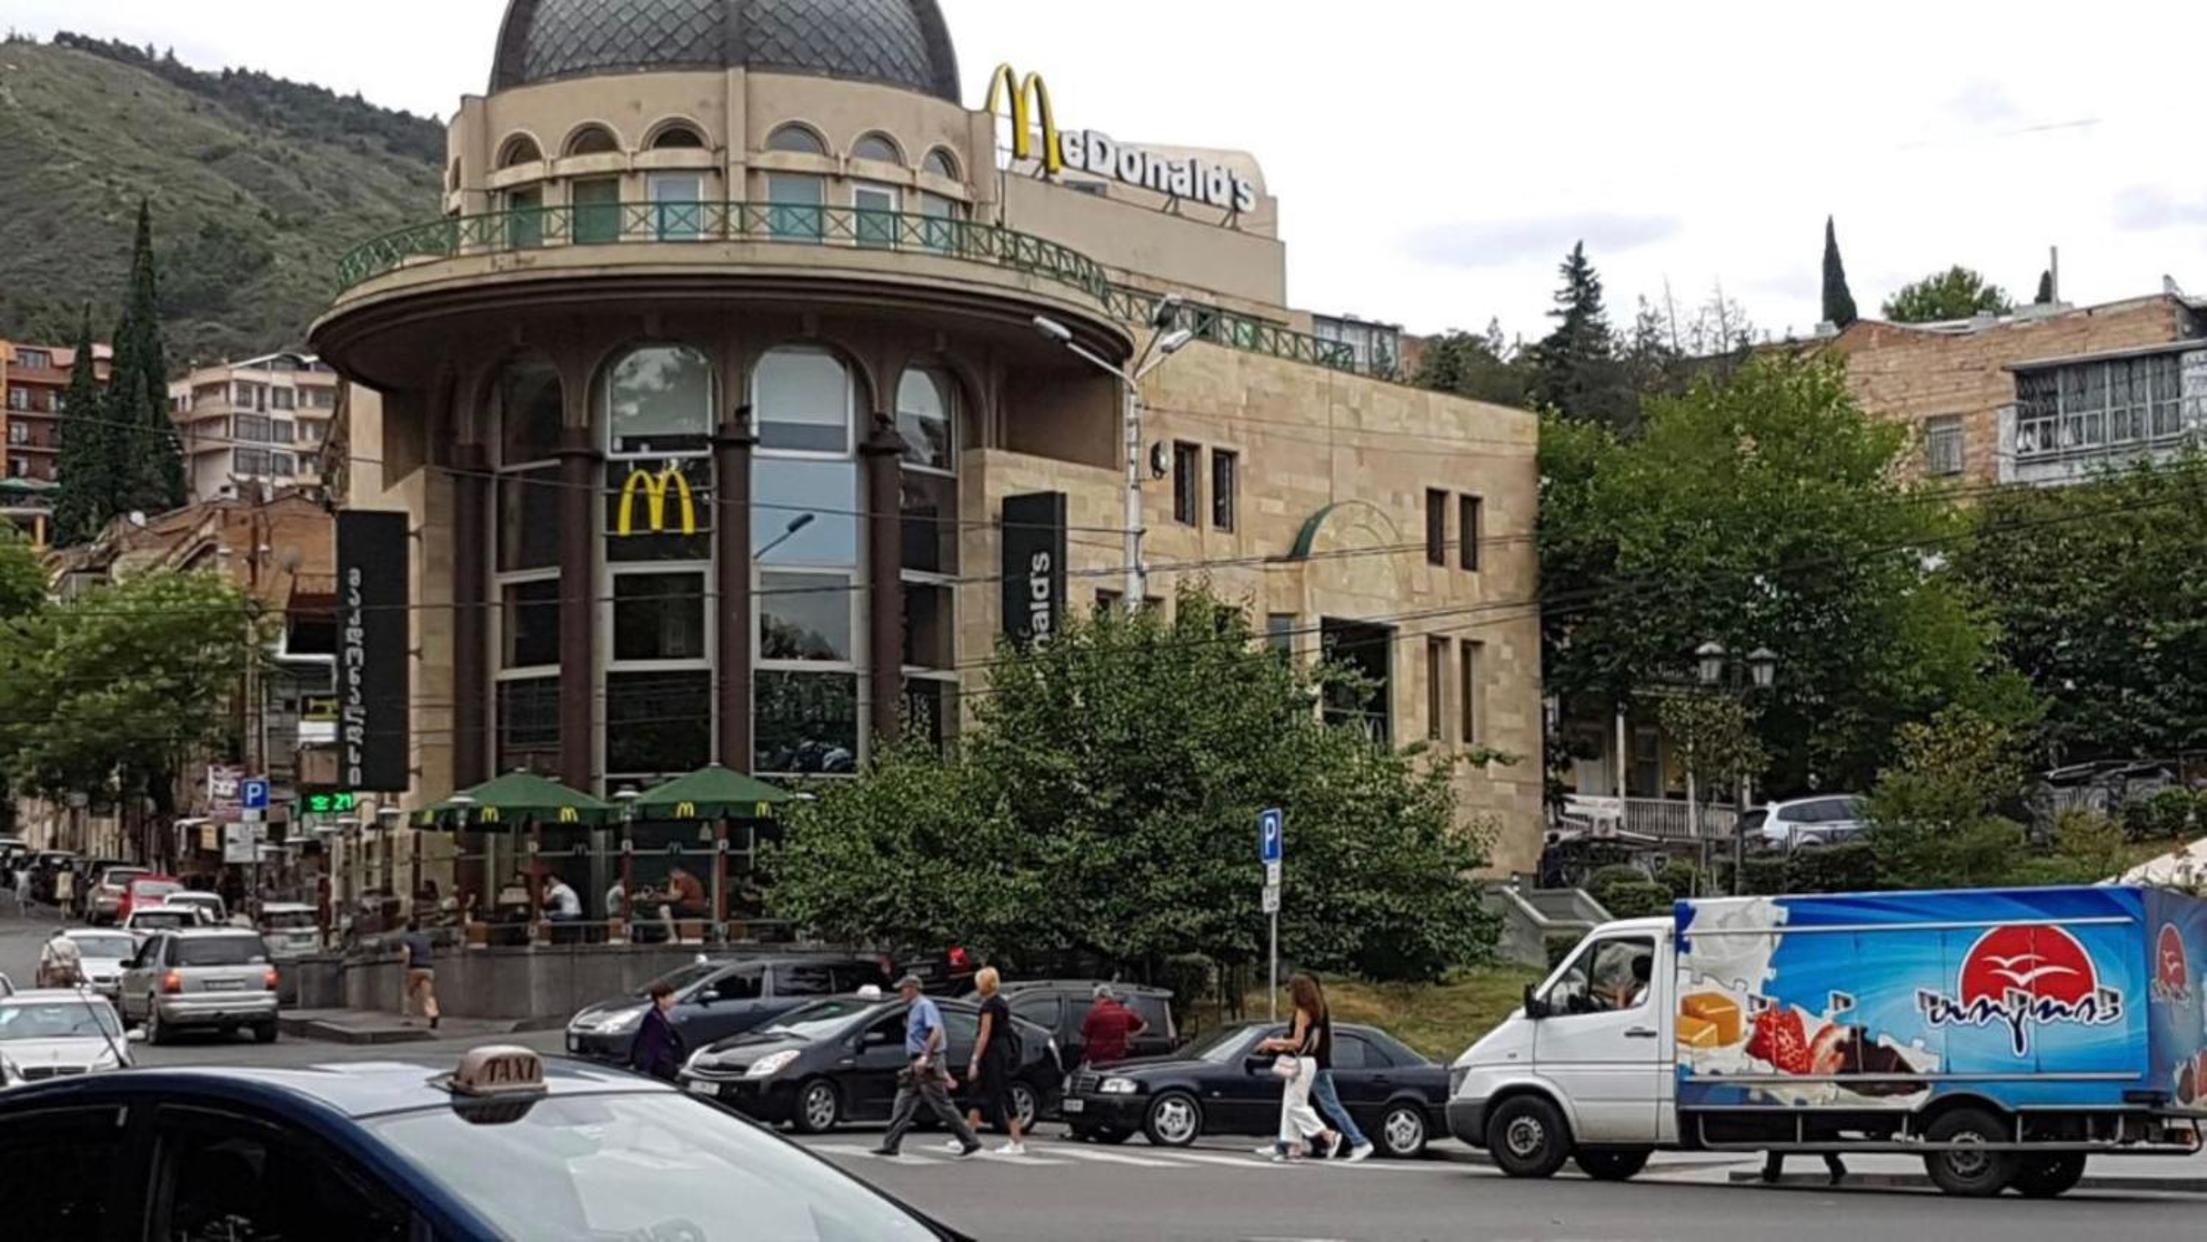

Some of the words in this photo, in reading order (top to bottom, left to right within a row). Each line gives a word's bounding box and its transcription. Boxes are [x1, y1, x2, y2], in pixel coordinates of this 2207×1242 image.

[1030, 552, 1050, 654] nald's
[247, 783, 263, 805] P
[1265, 816, 1277, 856] P
[482, 1058, 536, 1082] TAXI
